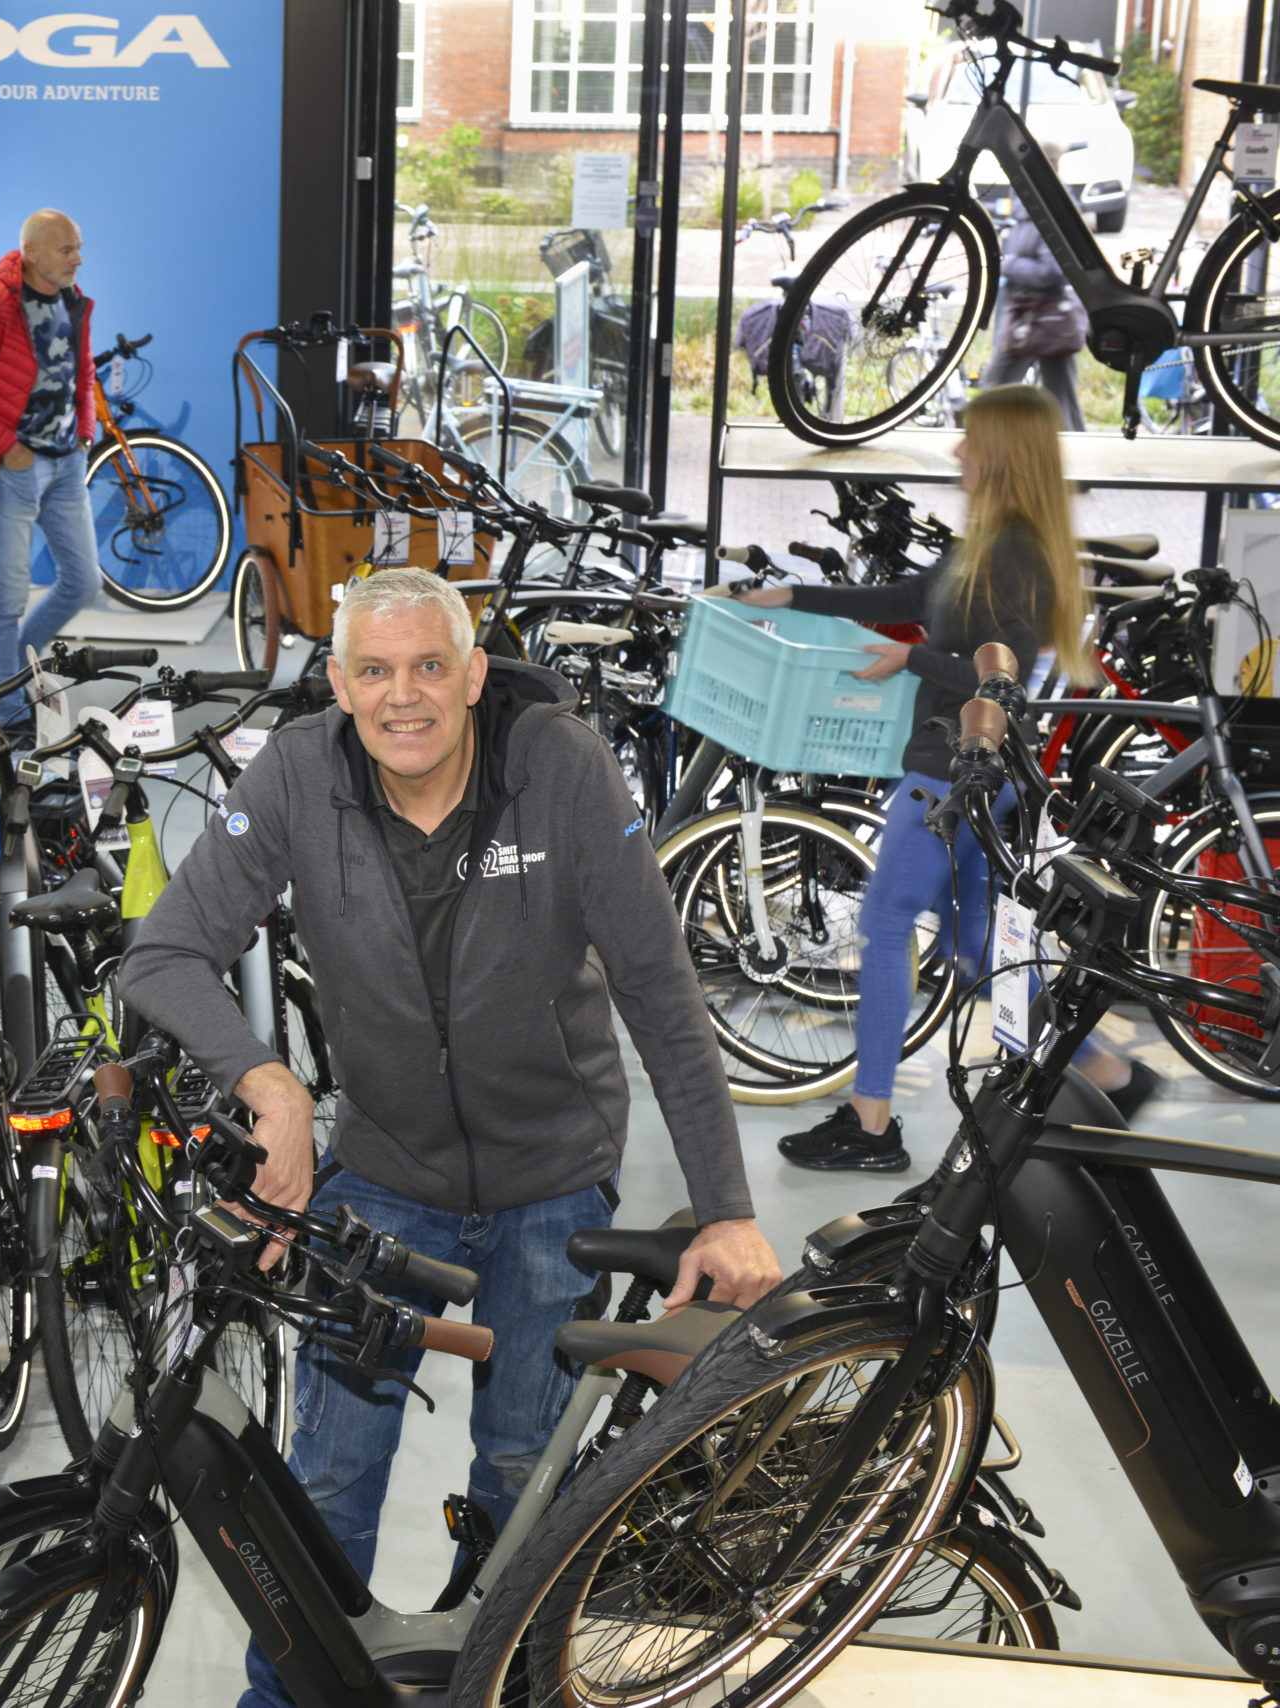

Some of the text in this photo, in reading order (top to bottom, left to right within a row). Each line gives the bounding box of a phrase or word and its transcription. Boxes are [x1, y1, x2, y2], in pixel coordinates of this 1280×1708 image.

[43, 85, 160, 101] ADVENTURE
[132, 729, 161, 739] Kalkhoff
[624, 818, 645, 838] KO
[498, 845, 518, 856] SMIT
[500, 863, 529, 875] WIELES
[1123, 1224, 1175, 1305] GAZELLE
[1090, 1299, 1149, 1388] GAZELLE
[239, 1542, 289, 1609] GAZELLE
